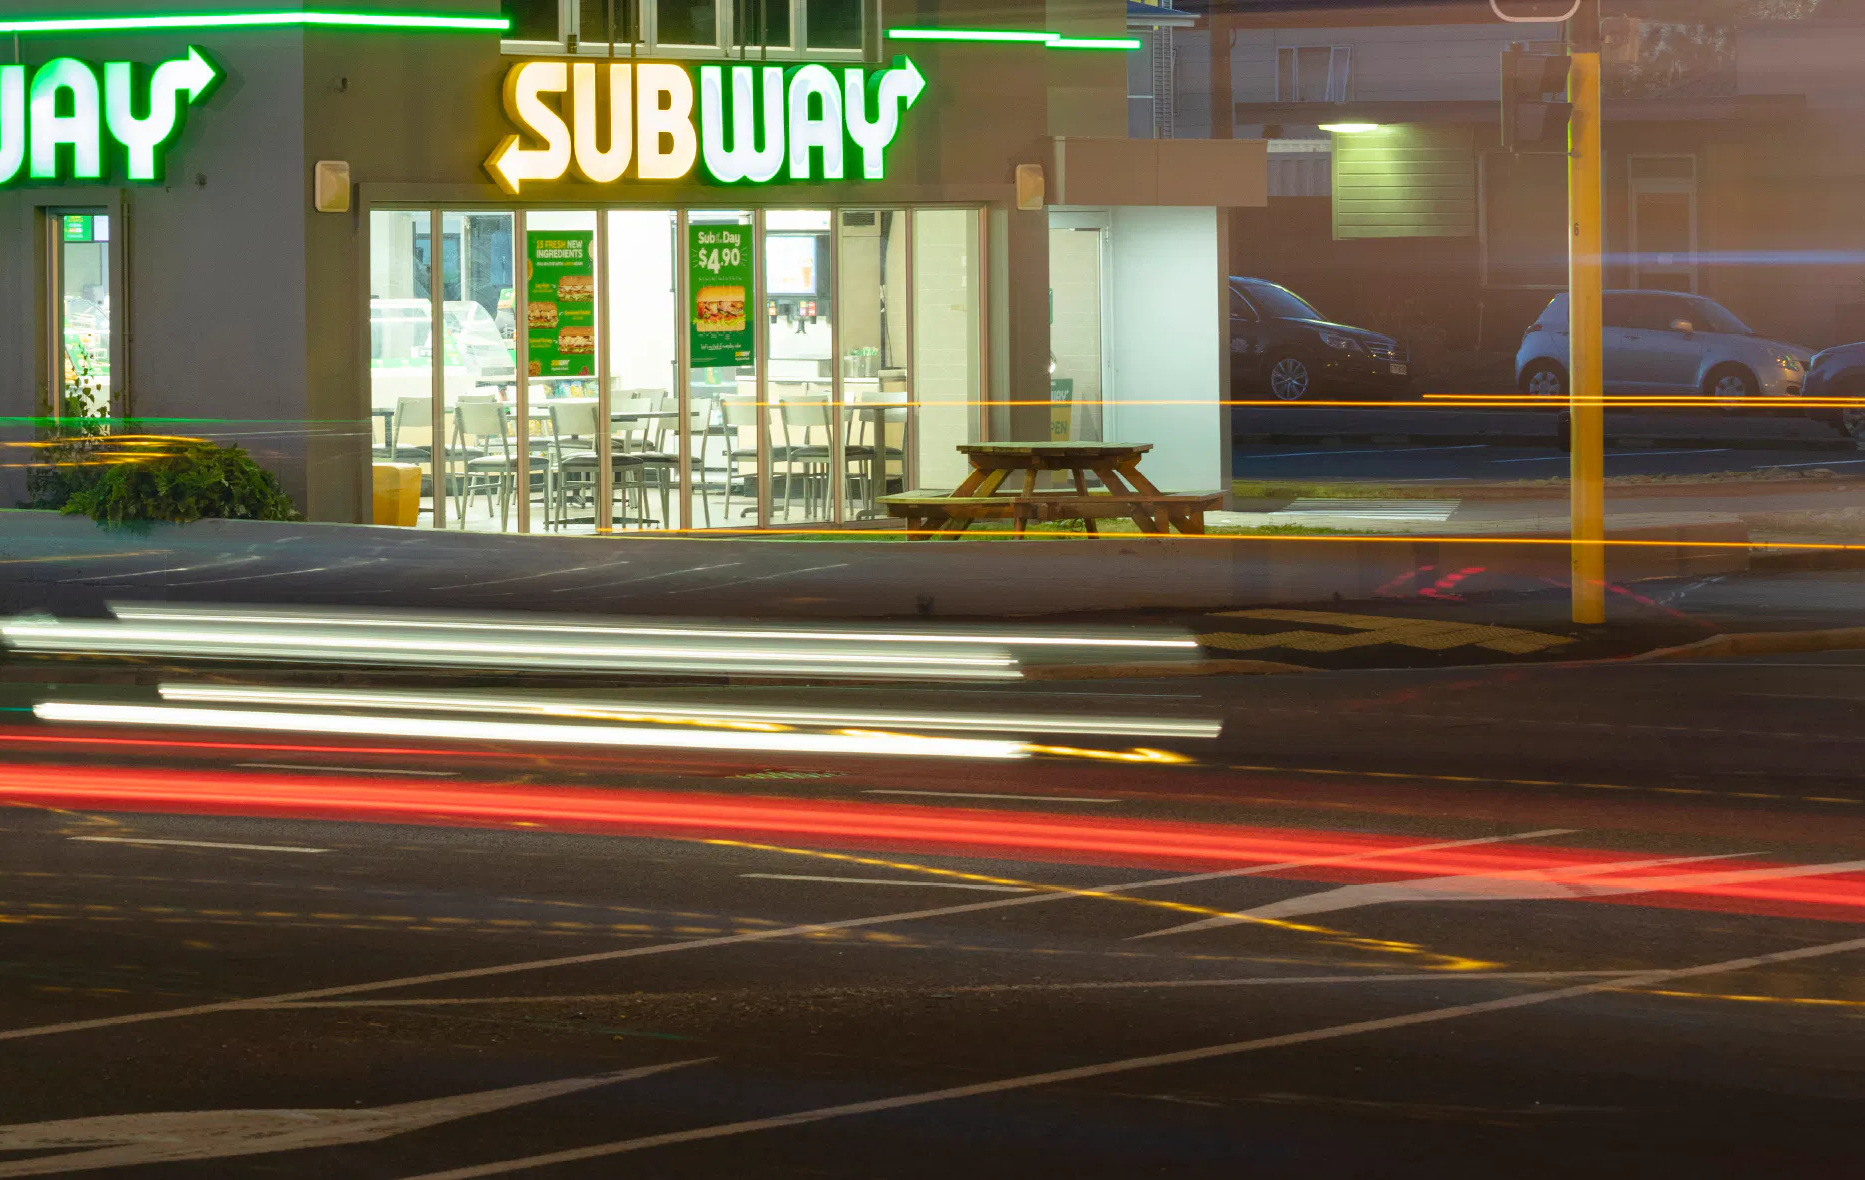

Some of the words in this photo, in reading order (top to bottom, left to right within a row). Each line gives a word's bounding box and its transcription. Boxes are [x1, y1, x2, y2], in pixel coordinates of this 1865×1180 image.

[486, 54, 927, 194] SUBWAY
[567, 240, 583, 249] NEW
[698, 231, 715, 244] Sub
[723, 231, 741, 247] Day
[536, 249, 583, 258] INGREDIENTS
[698, 247, 741, 274] $4.90
